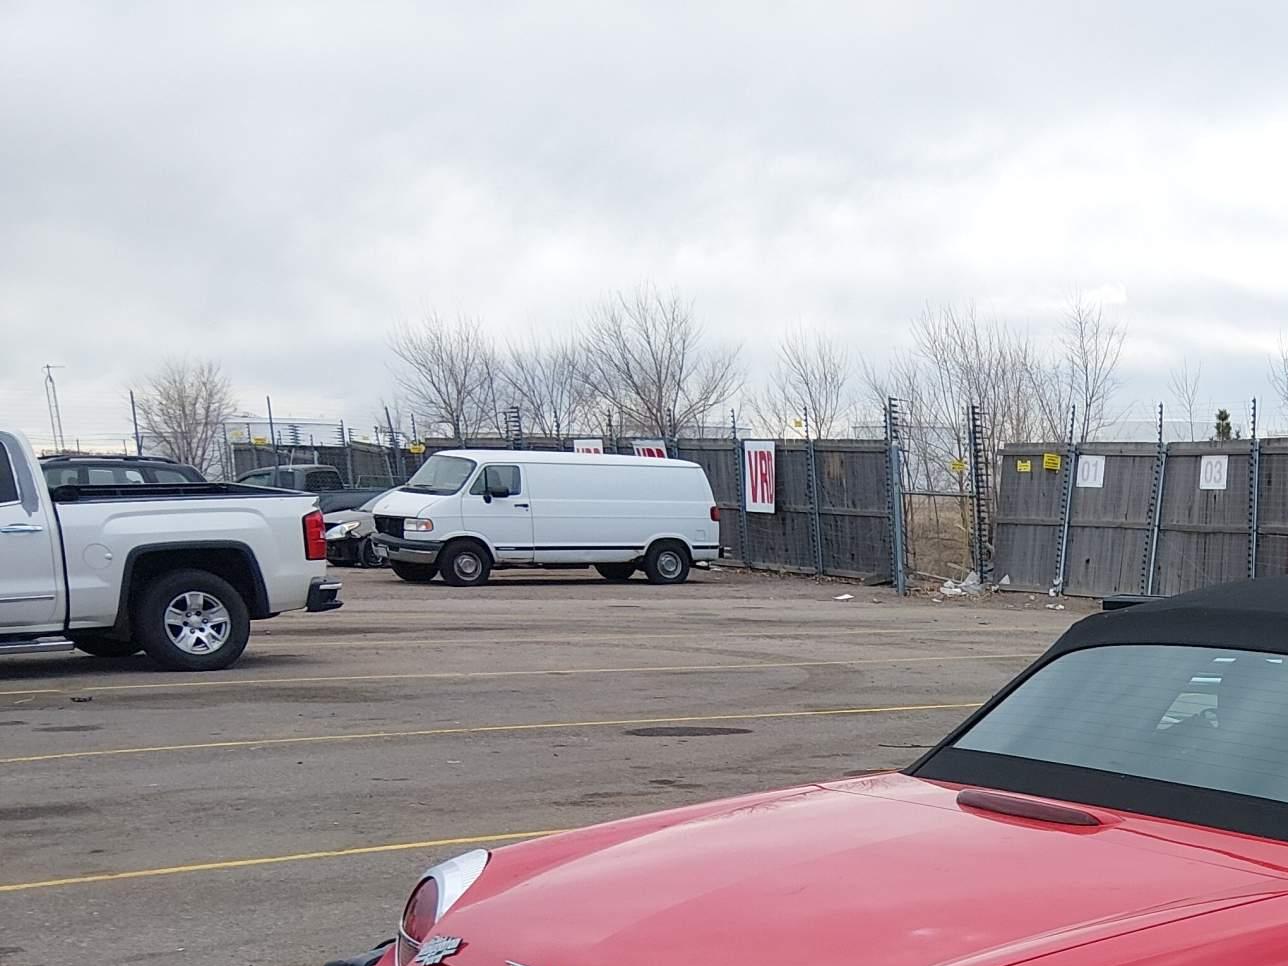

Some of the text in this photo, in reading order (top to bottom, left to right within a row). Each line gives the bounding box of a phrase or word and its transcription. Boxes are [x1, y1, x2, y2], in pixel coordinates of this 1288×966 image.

[747, 450, 774, 504] VRD
[1081, 460, 1099, 482] 01
[1203, 459, 1223, 484] 03
